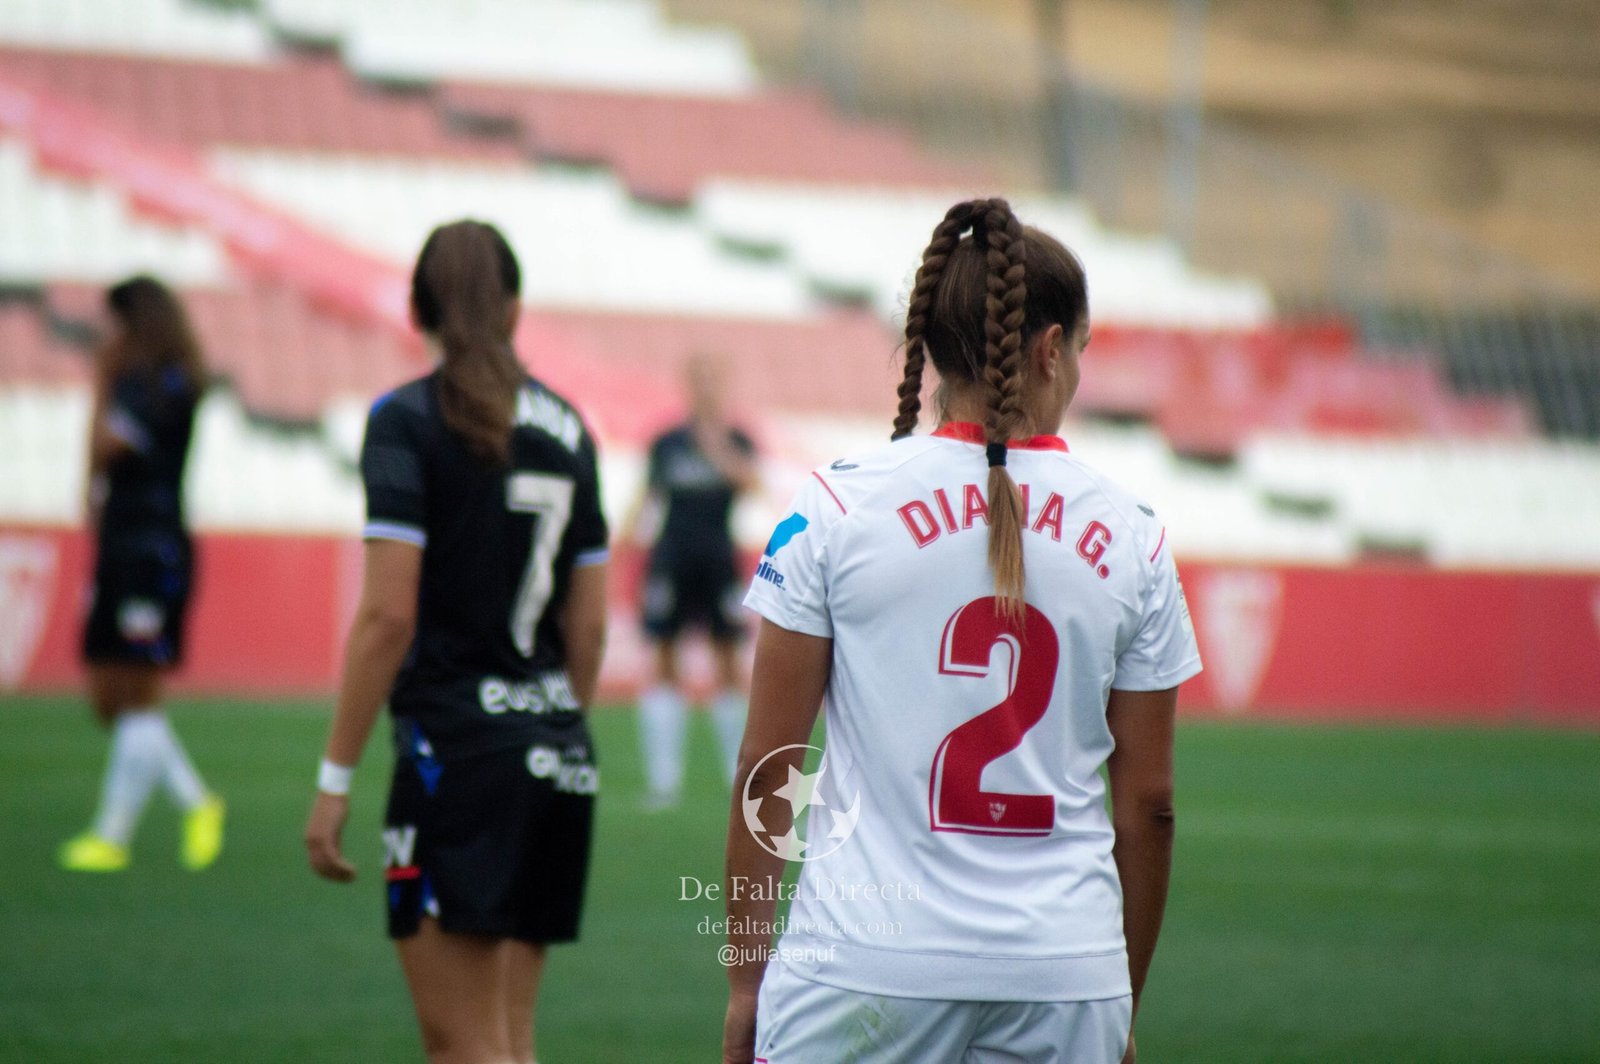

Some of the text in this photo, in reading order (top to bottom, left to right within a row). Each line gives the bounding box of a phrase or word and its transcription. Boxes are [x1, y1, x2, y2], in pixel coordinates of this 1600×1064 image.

[506, 472, 576, 658] 7
[1076, 520, 1112, 579] G.
[929, 596, 1059, 837] 2
